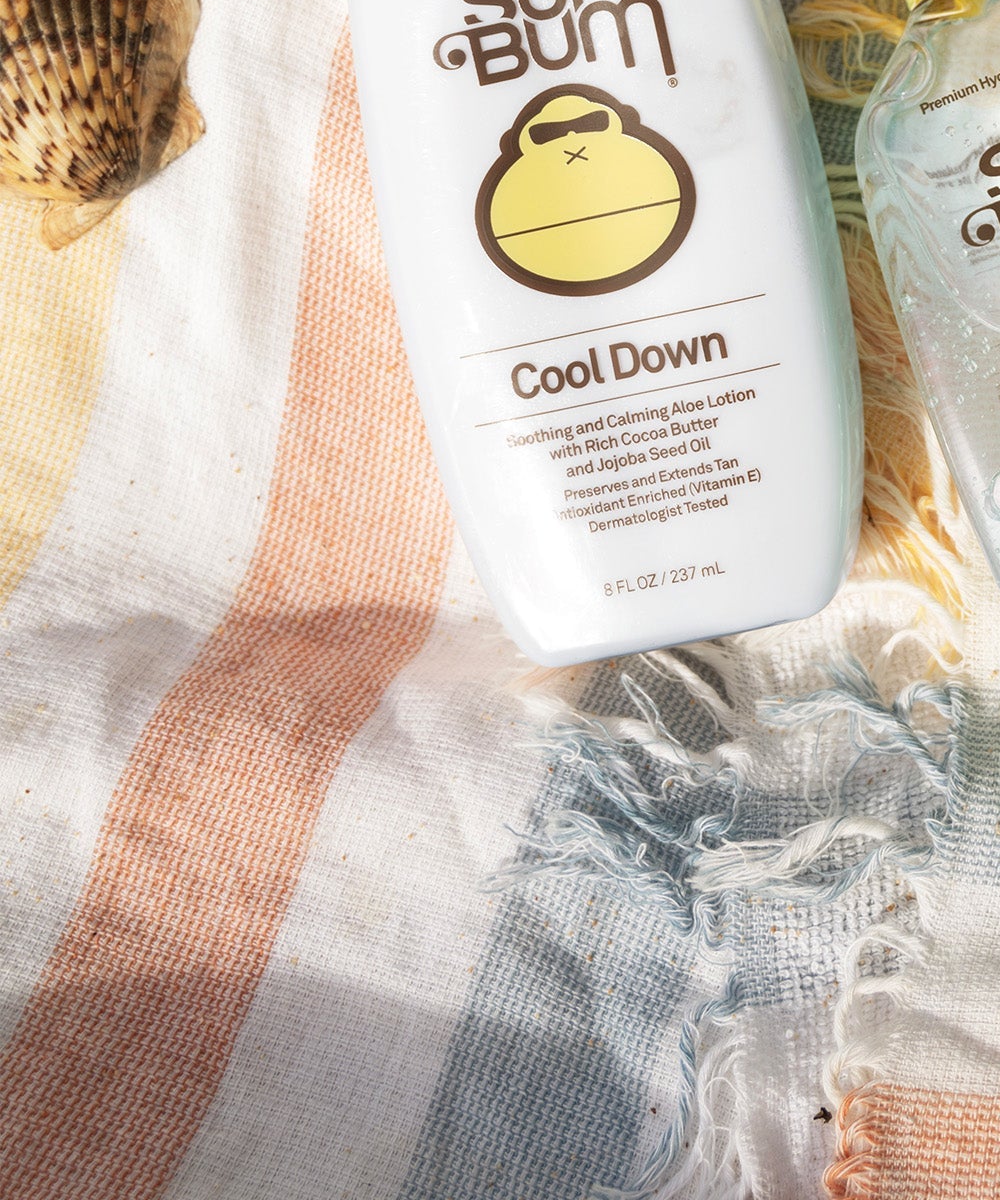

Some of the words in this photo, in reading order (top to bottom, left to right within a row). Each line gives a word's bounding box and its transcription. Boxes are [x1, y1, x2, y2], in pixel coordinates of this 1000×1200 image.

[918, 83, 980, 116] Premium
[510, 346, 606, 400] Cool
[608, 331, 729, 382] Down
[575, 416, 605, 436] and
[605, 405, 671, 429] Calming
[671, 399, 705, 417] Aloe
[706, 388, 757, 409] Lotion
[548, 442, 583, 461] with
[584, 435, 619, 454] Rich
[620, 427, 669, 447] Cocoa
[669, 416, 720, 437] Butter
[565, 459, 595, 478] and
[596, 451, 648, 473] Jojoba
[648, 440, 688, 462] Seed
[689, 435, 712, 453] Oil
[555, 497, 627, 522] ntioxidant
[626, 484, 687, 508] Enriched
[688, 473, 746, 497] (Vitamin
[746, 467, 762, 483] E)
[563, 480, 630, 502] Preserves
[630, 471, 657, 489] and
[657, 461, 714, 483] Extends
[713, 457, 740, 472] Tan
[587, 504, 684, 534] Dermatologist
[682, 493, 729, 514] Tested
[603, 582, 614, 598] 8
[615, 578, 636, 595] FL
[636, 572, 659, 591] OZ
[669, 565, 697, 584] 237
[700, 561, 726, 578] mL
